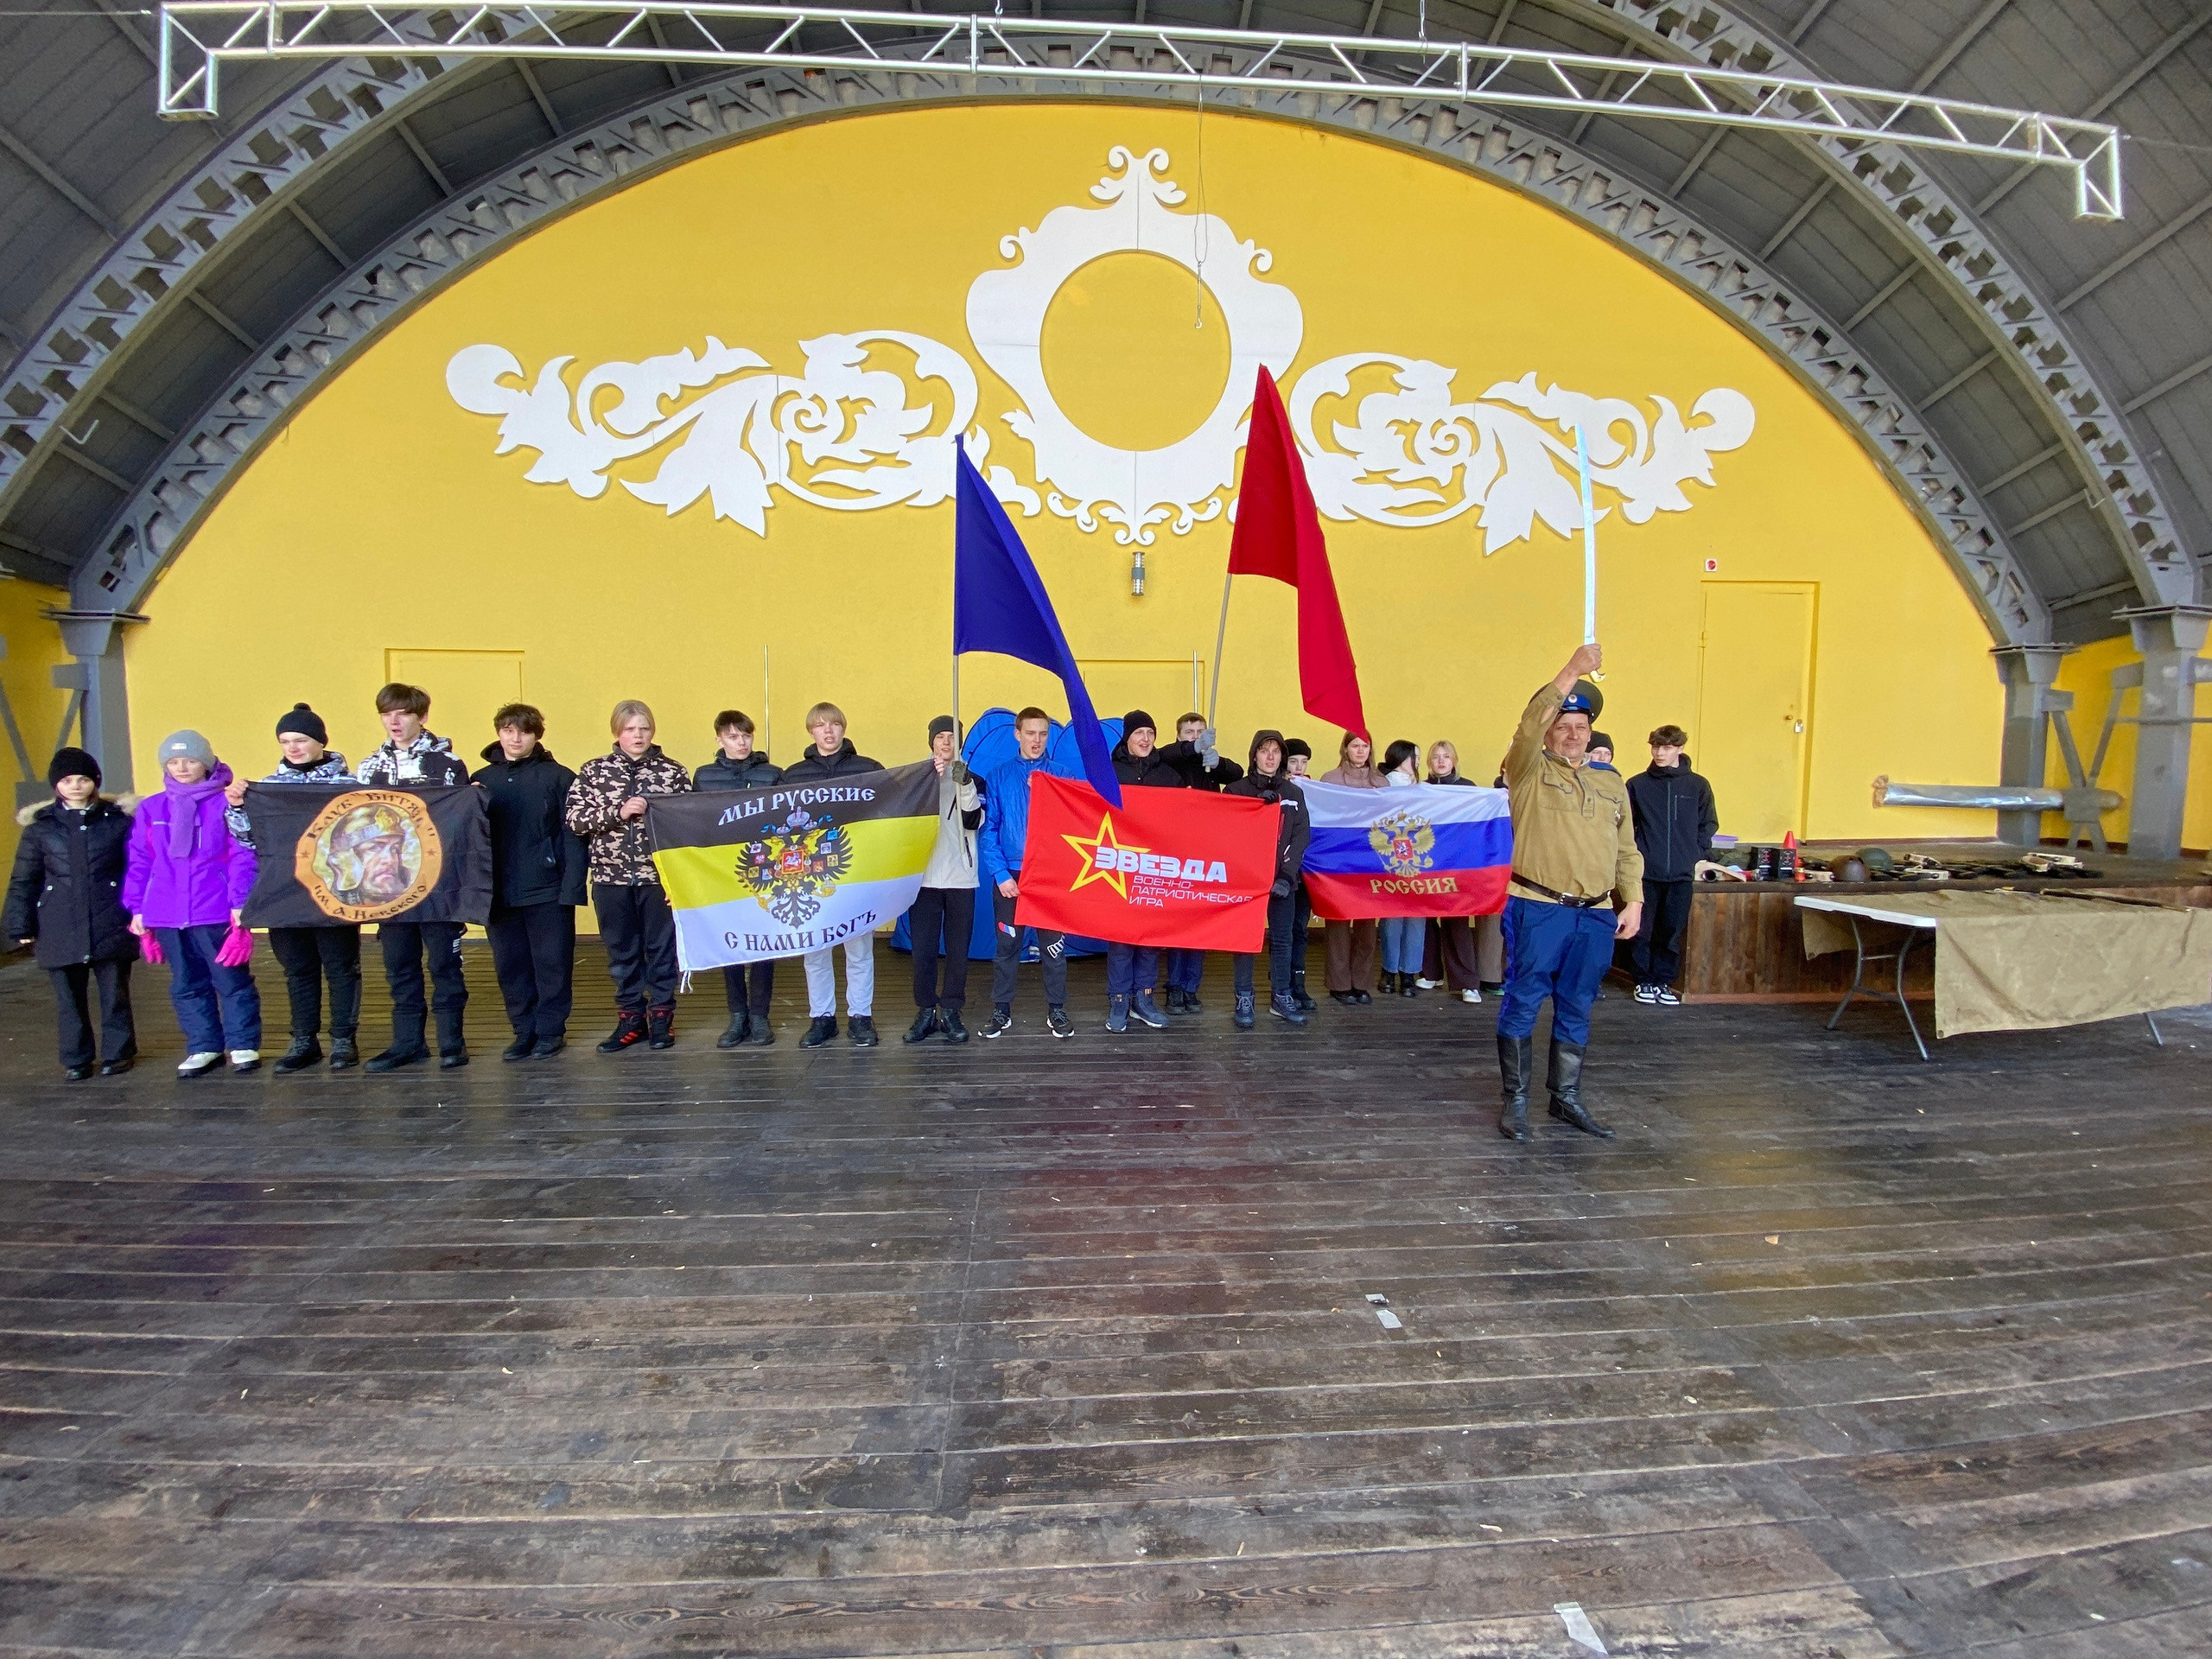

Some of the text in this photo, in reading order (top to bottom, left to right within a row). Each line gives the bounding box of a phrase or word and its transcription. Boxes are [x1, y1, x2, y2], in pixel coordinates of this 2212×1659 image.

[718, 787, 875, 826] МЫ РУССКИЕ
[1095, 846, 1227, 883] ЗВЕЗДА
[1133, 875, 1194, 889] ВОЕННО-
[1370, 877, 1459, 894] РОССИЯ
[1129, 895, 1164, 908] ИГРА
[724, 909, 877, 951] С НАМИ БОГЪ
